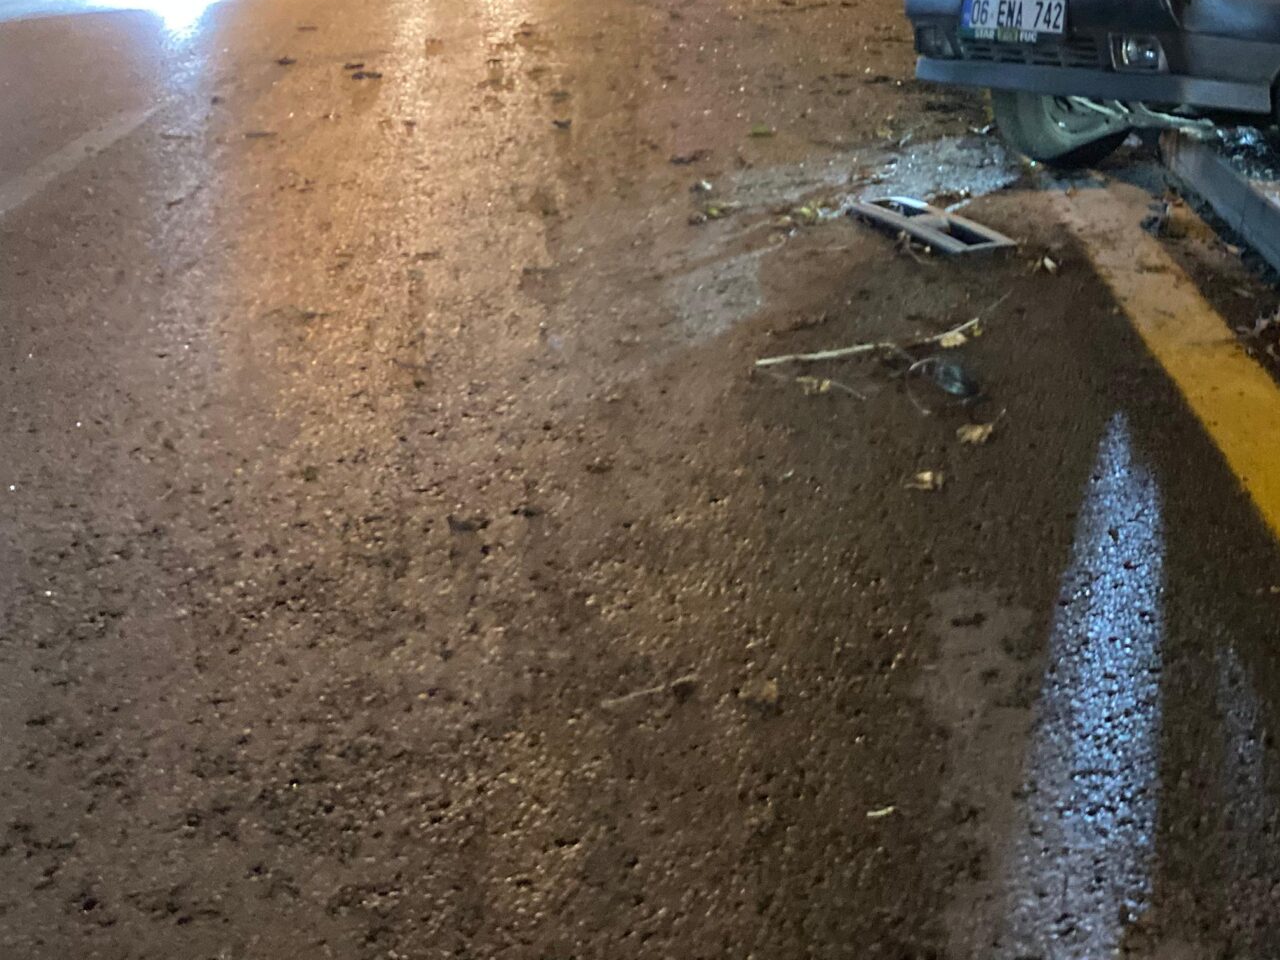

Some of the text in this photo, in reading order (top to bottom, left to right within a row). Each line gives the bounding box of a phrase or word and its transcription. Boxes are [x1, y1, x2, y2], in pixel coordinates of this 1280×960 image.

[971, 0, 1063, 29] 06 ENA 742
